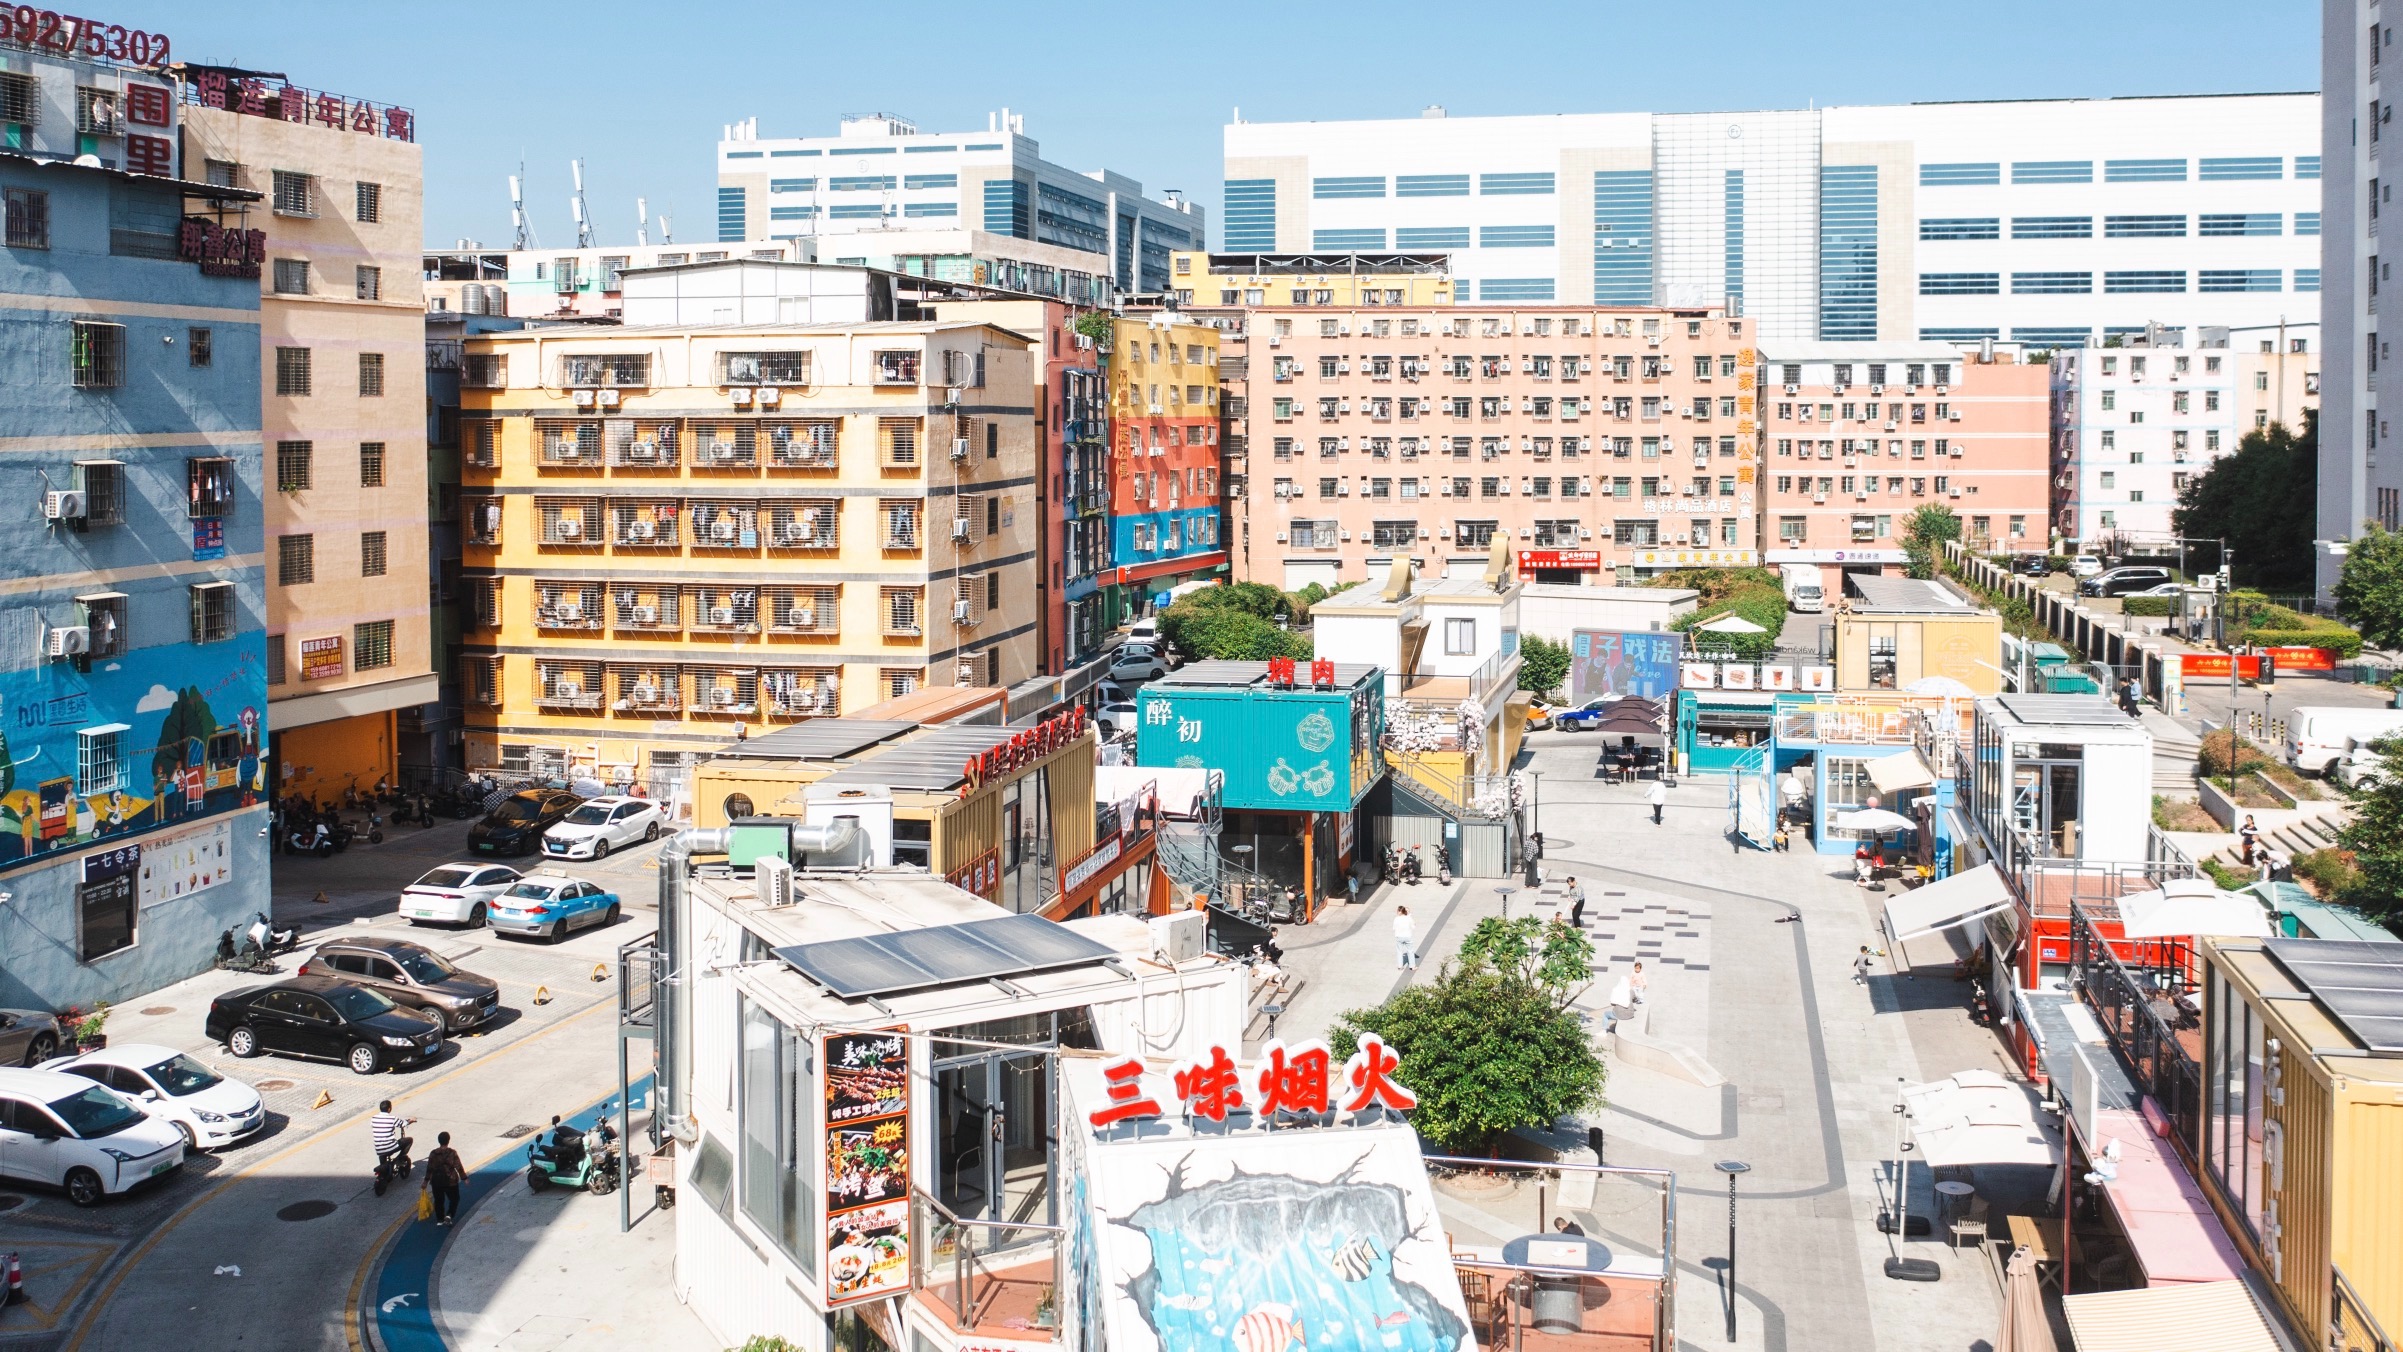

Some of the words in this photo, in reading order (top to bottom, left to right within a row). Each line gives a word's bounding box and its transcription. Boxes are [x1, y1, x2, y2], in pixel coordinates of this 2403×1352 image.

[197, 69, 411, 142] 榴莲青年公寓
[127, 83, 171, 178] 围里
[181, 220, 267, 263] 翔鑫公寓
[1736, 347, 1755, 485] 逸家青年公寓
[1643, 499, 1732, 513] 格林尚品酒店
[1739, 491, 1753, 519] 公寓
[1267, 655, 1335, 685] 烤肉
[1146, 699, 1202, 743] 醉初
[87, 846, 139, 868] 一七令茶
[842, 1036, 904, 1066] 美味烧烤
[875, 1087, 901, 1101] 2元起
[1088, 1037, 1417, 1127] 三味烟火
[839, 1174, 886, 1200] 烤鱼
